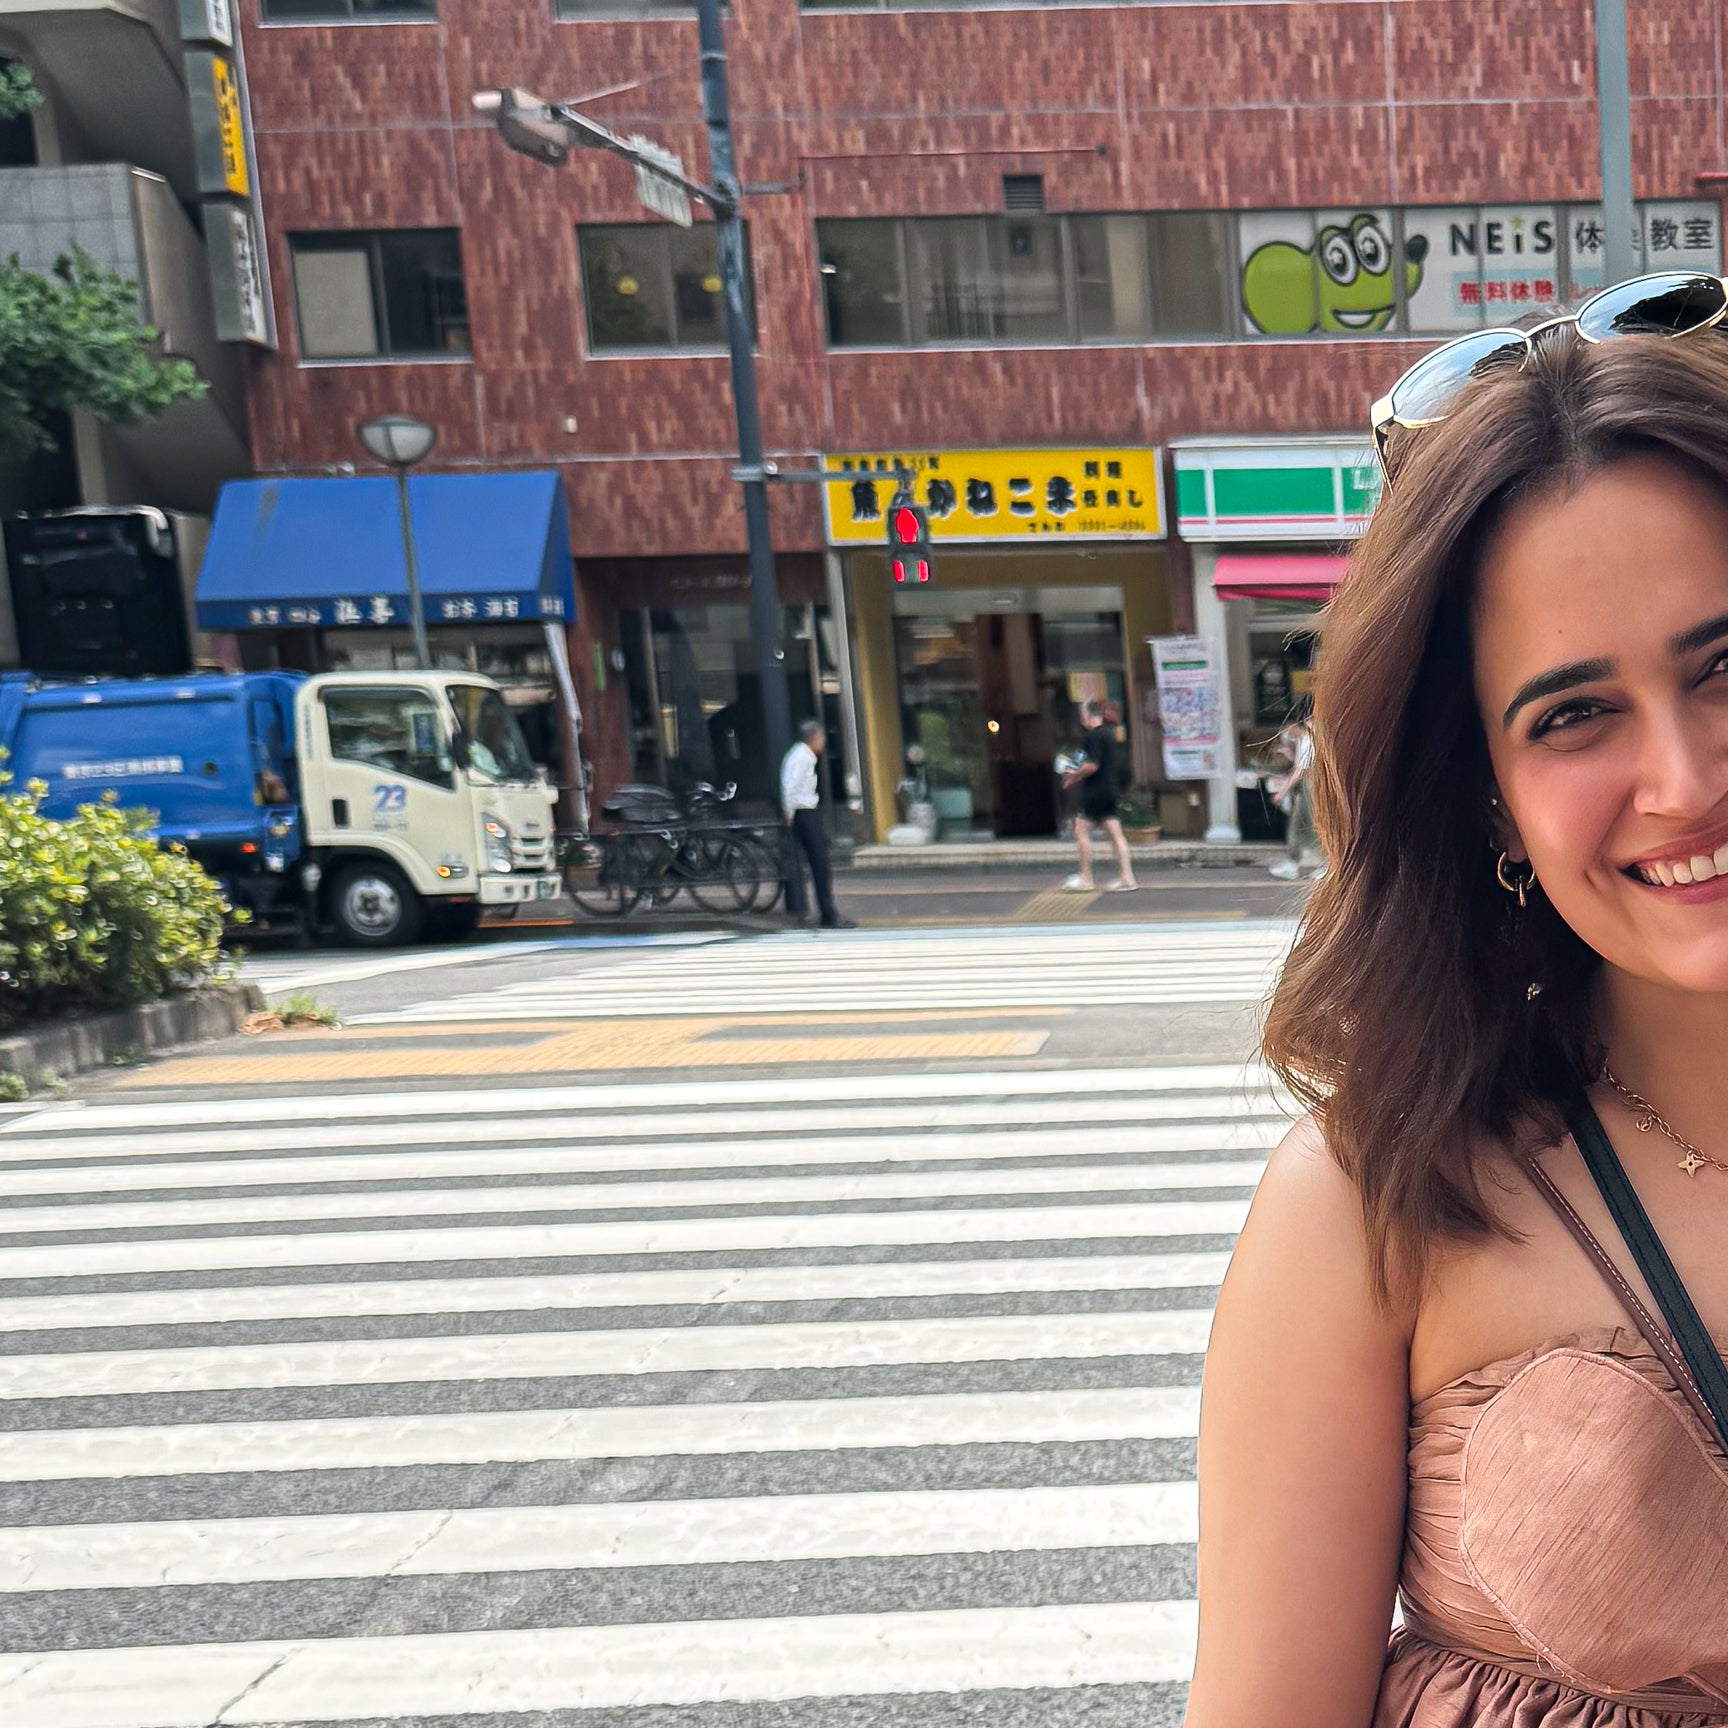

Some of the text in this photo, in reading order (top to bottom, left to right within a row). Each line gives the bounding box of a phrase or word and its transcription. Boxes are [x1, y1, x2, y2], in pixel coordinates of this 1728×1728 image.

[1575, 217, 1715, 254] 体教室
[1458, 278, 1554, 305] 無料体験
[374, 785, 406, 812] 23
